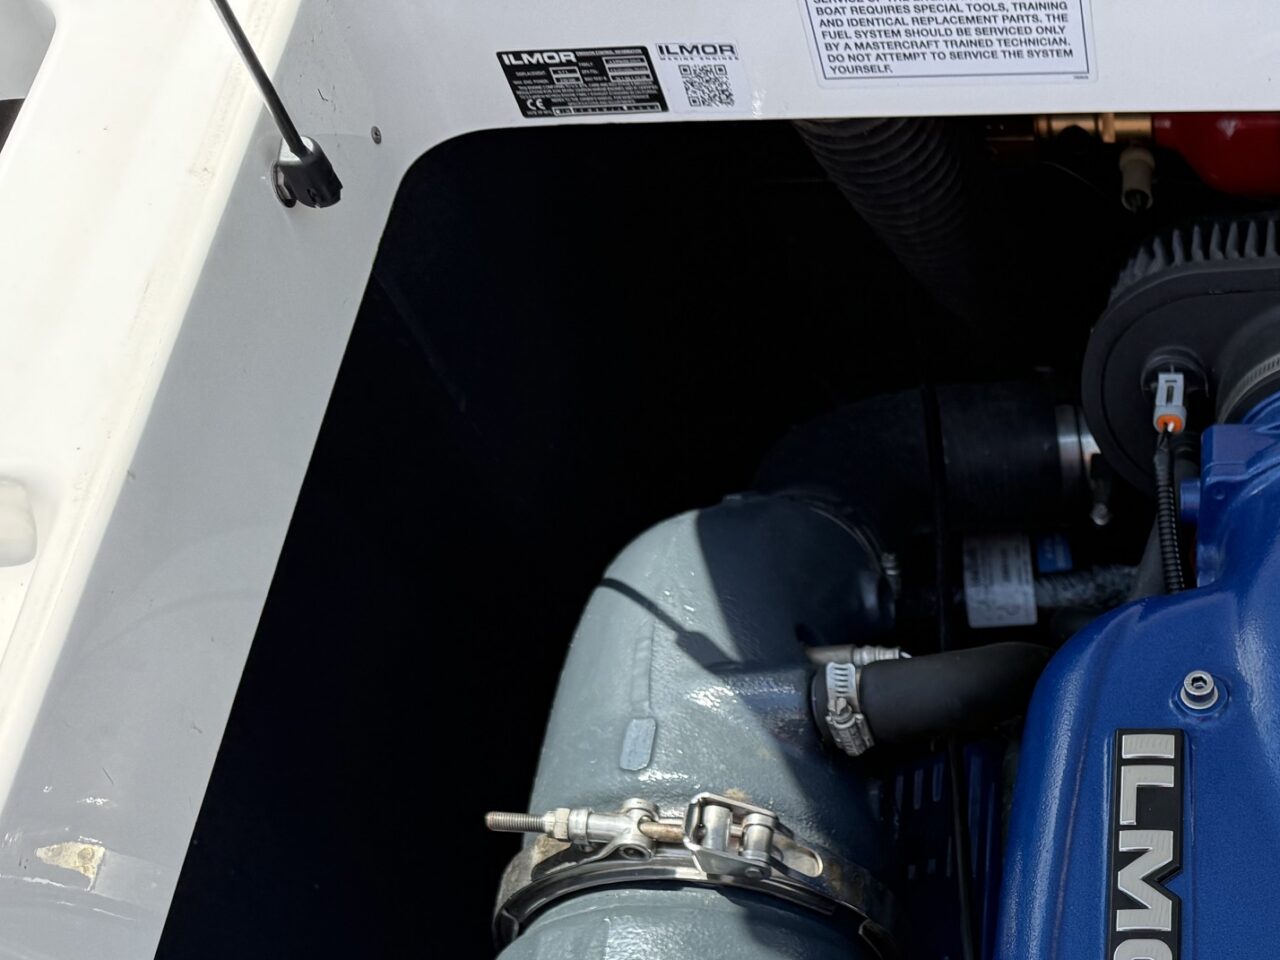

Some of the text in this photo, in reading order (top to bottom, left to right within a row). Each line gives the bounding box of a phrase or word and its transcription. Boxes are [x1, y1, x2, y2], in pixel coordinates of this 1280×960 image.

[815, 1, 1068, 16] BOAT REQUIRES SPECIAL TOOLS, TRAINING
[819, 13, 1069, 28] AND IDENTICAL REPLACEMENT PARTS. THE
[821, 25, 1066, 40] FUEL SYSTEM SHOULD BE SERVICED ONLY
[657, 44, 736, 55] ILMOR
[824, 37, 1071, 51] BY A MASTERCRAFT TRAINED TECHNICIAN.
[501, 52, 577, 66] ILMOR
[827, 48, 1073, 63] DO NOT ATTEMPT TO SERVICE THE SYSTEM
[526, 99, 544, 110] CE
